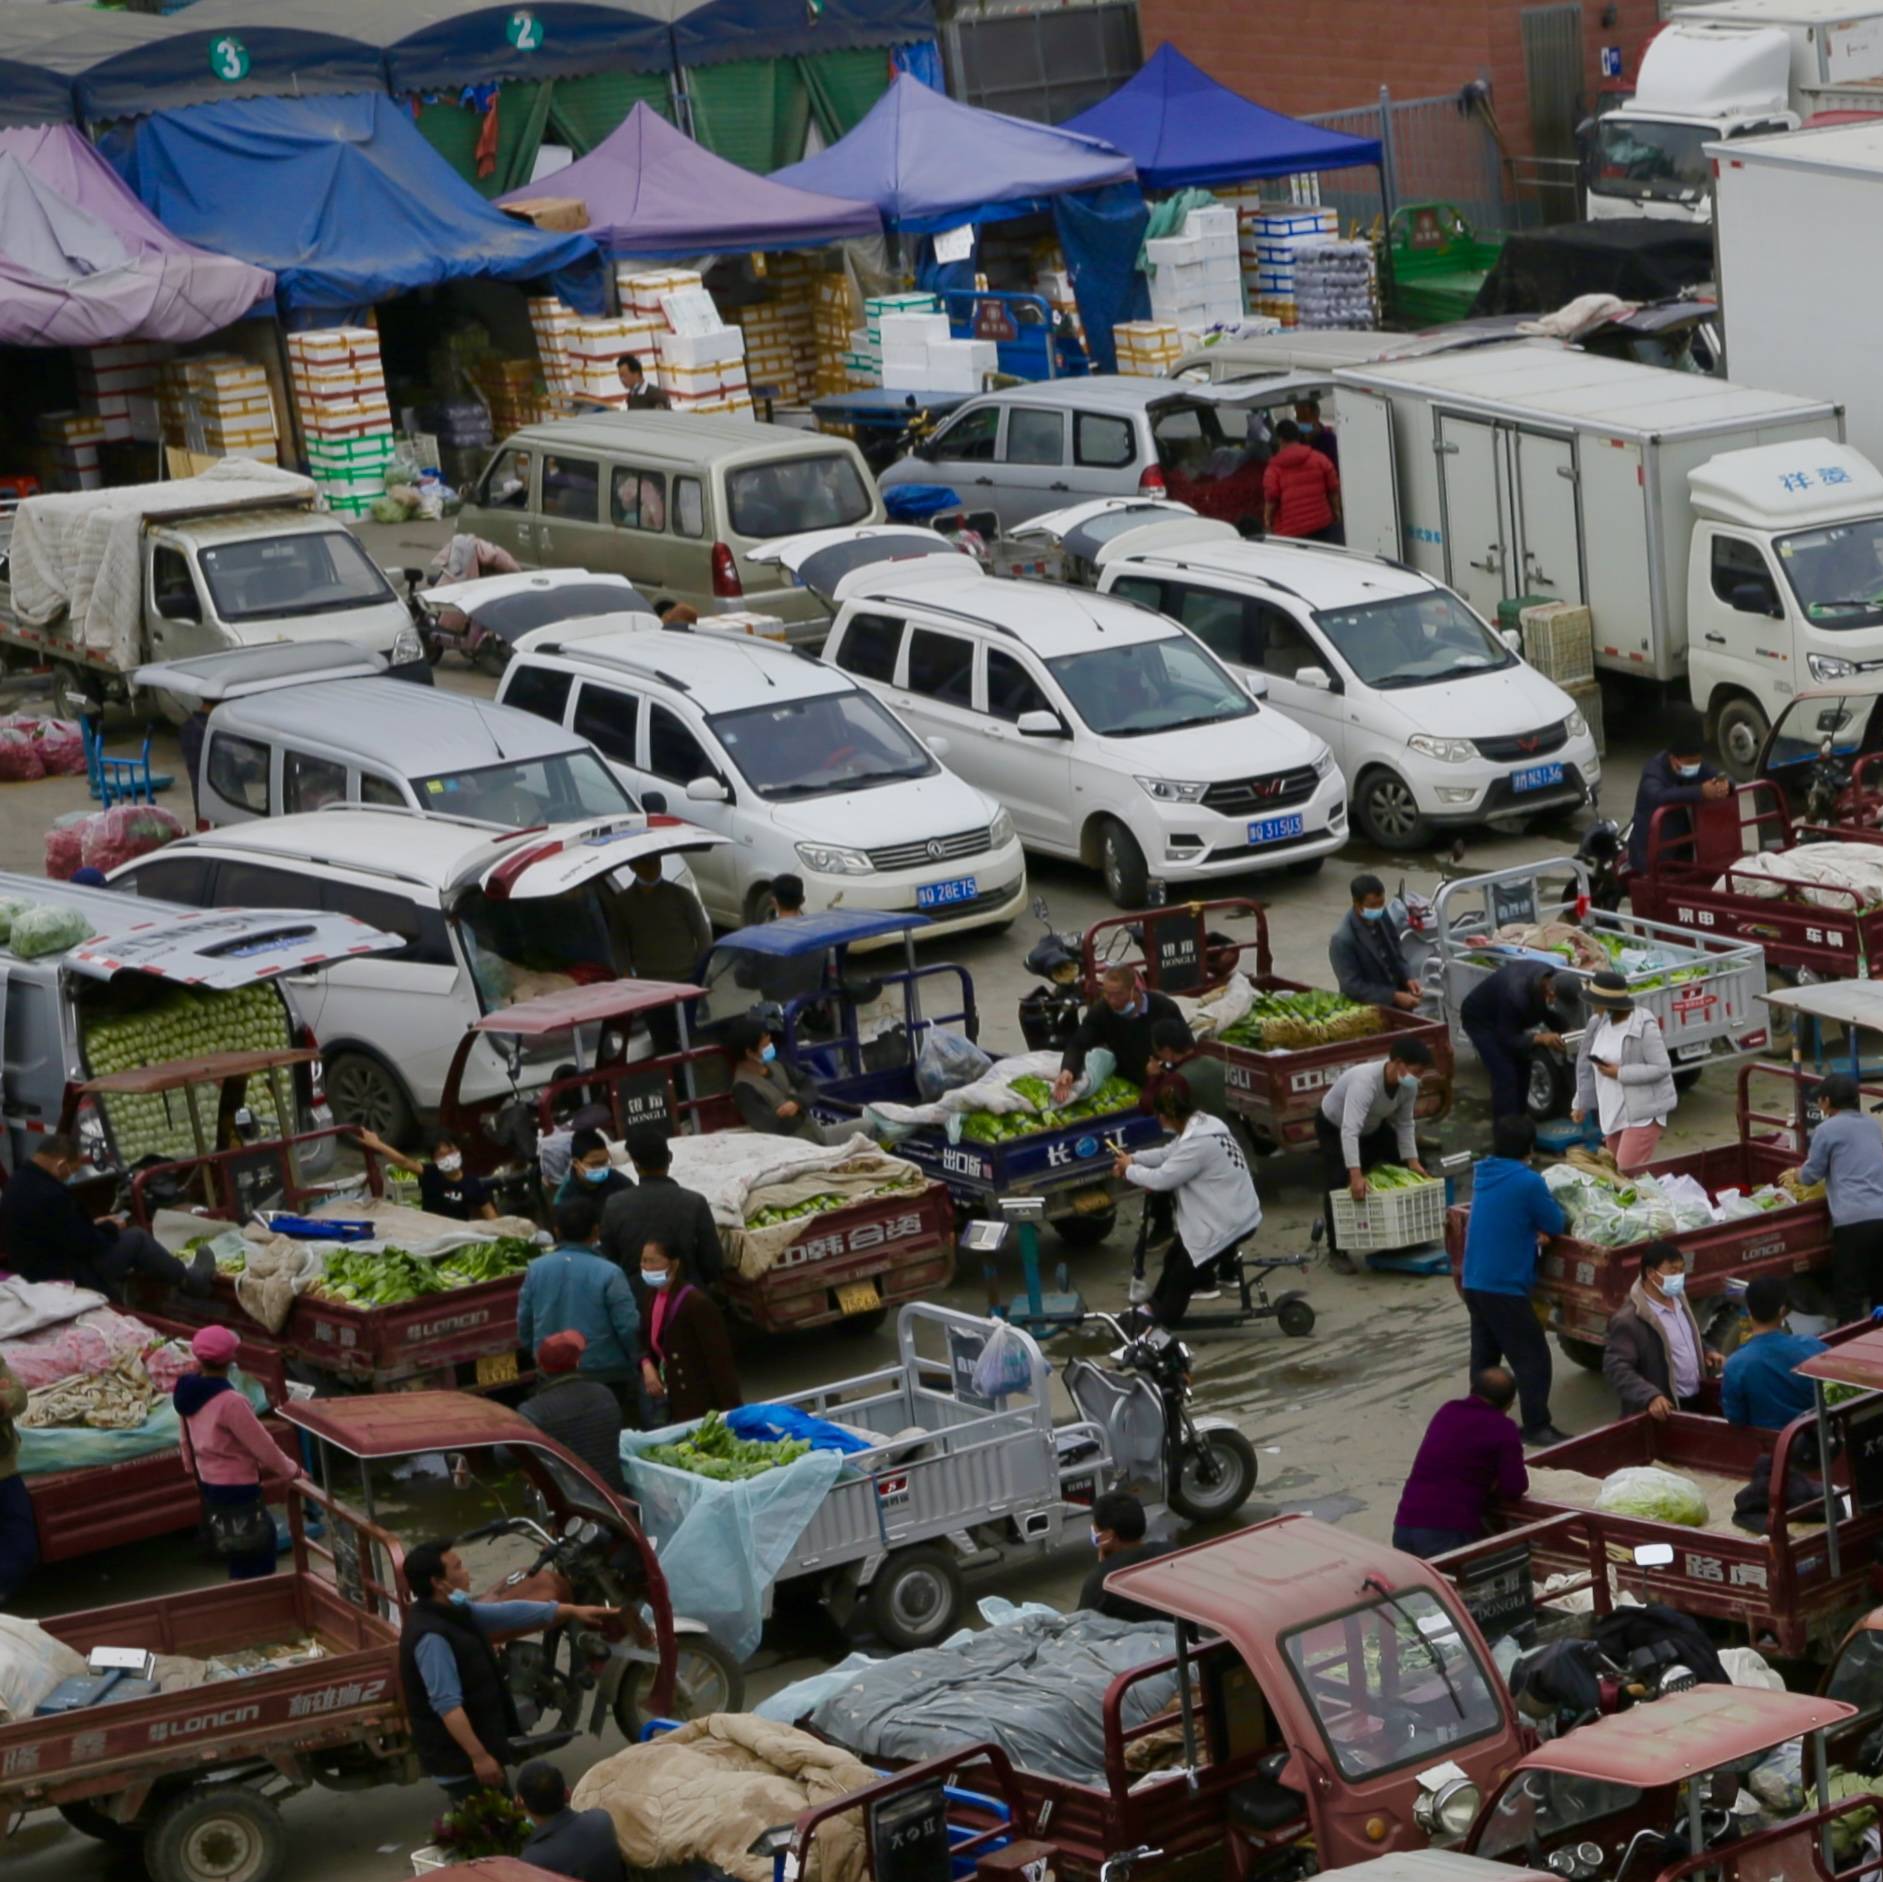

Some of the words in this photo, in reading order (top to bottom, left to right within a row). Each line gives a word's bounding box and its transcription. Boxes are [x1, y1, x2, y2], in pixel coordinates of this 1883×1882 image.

[514, 13, 536, 50] 2
[217, 39, 242, 80] 3
[1742, 1242, 1787, 1262] LONCIN
